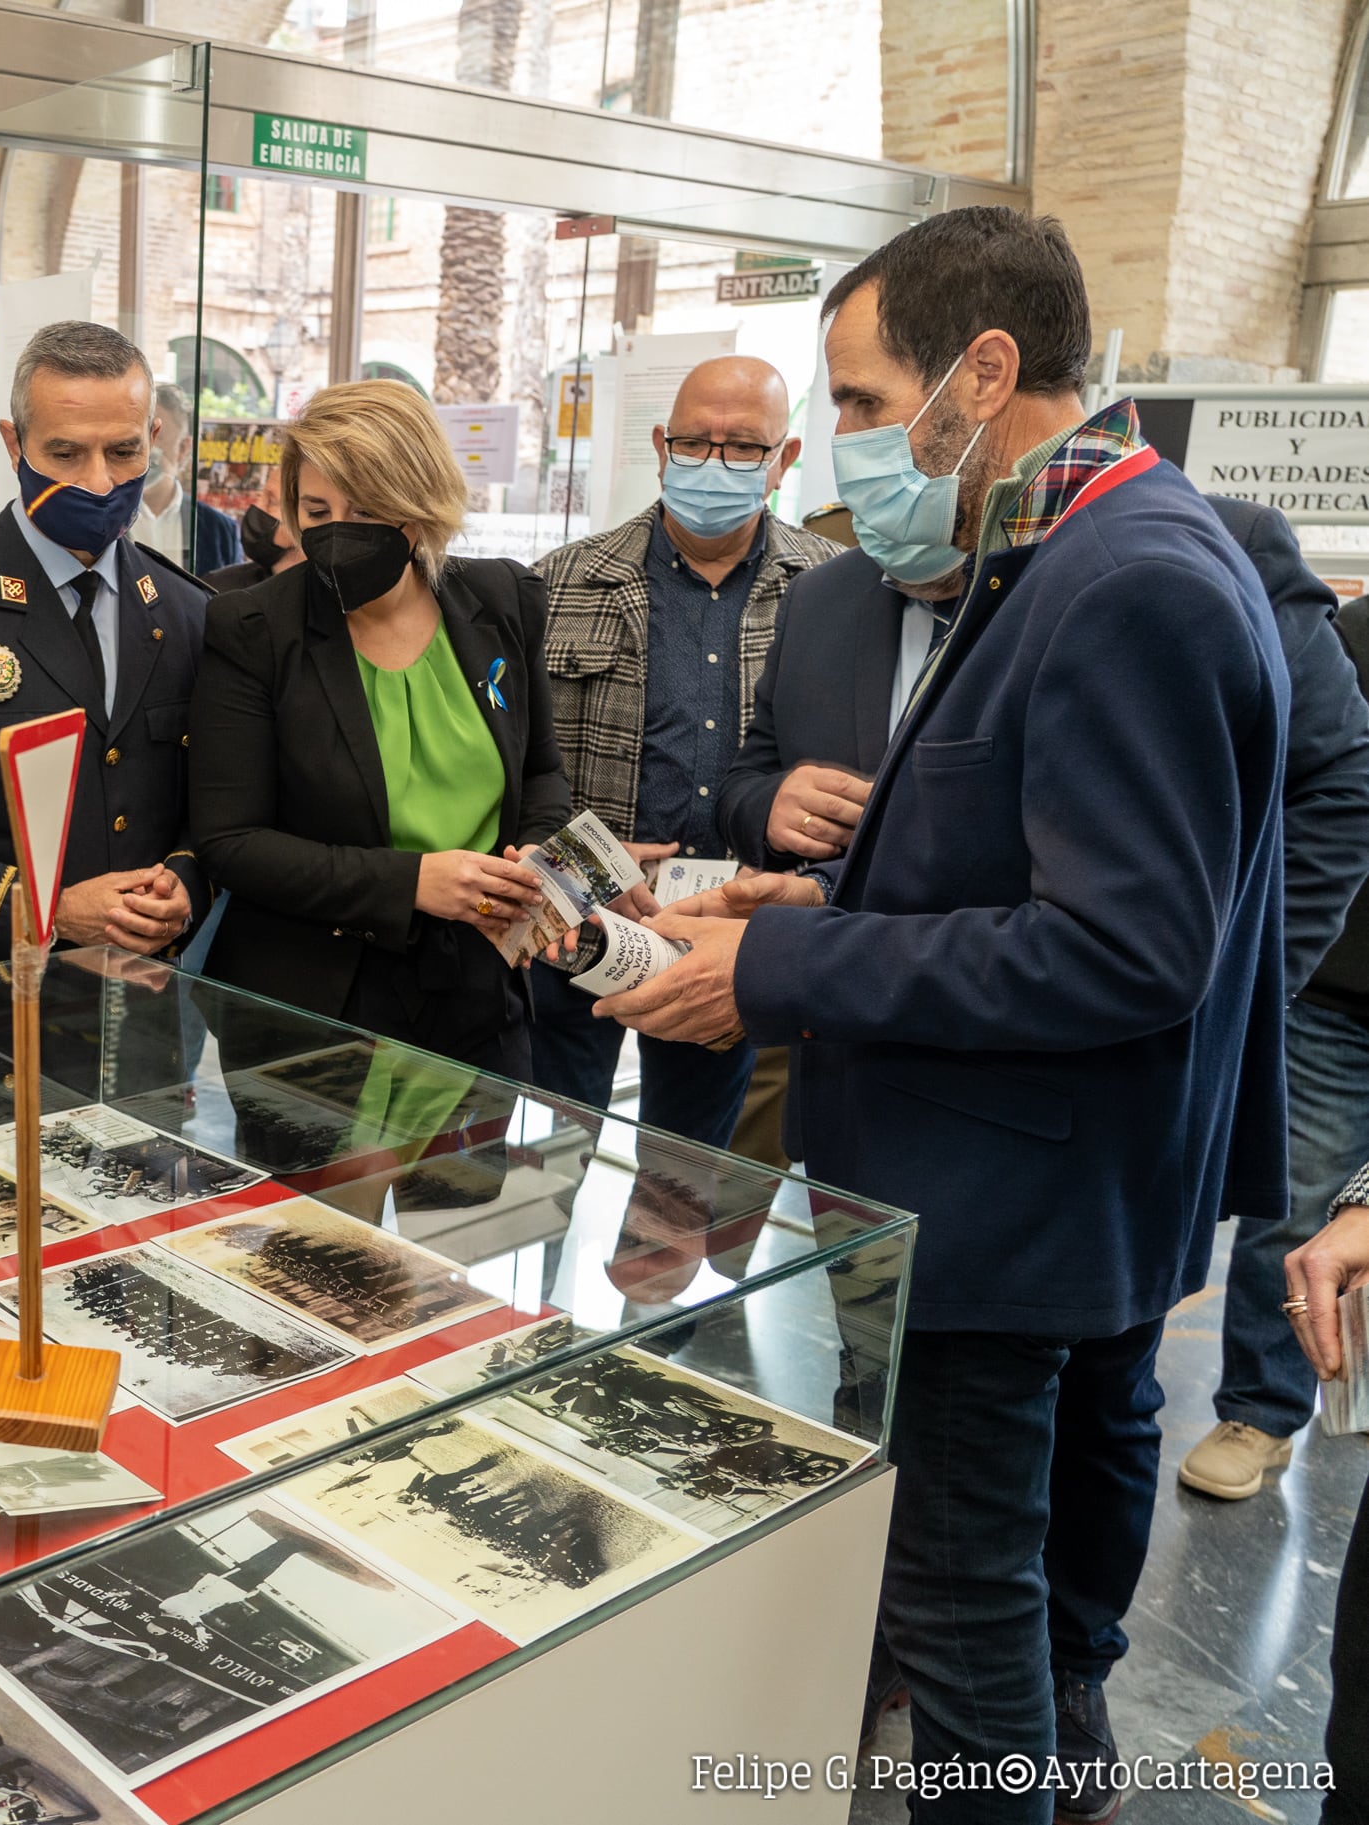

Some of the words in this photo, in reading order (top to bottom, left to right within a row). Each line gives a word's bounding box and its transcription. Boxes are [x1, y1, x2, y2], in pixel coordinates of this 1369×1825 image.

[270, 119, 328, 146] SALIDA
[333, 127, 352, 149] DE
[259, 143, 361, 175] EMERGENCIA
[720, 272, 816, 299] ENTRADA
[1217, 410, 1369, 428] PUBLICIDA
[1289, 437, 1307, 456] Y
[582, 822, 613, 853] EXPOSICIÓN
[632, 930, 642, 943] EN
[605, 966, 618, 978] 40
[616, 933, 627, 966] AÑOS
[612, 925, 635, 981] EDUCACIÓN
[627, 933, 652, 990] CARTAGENA
[633, 946, 644, 969] VIAL
[209, 1653, 275, 1688] JOVELCA
